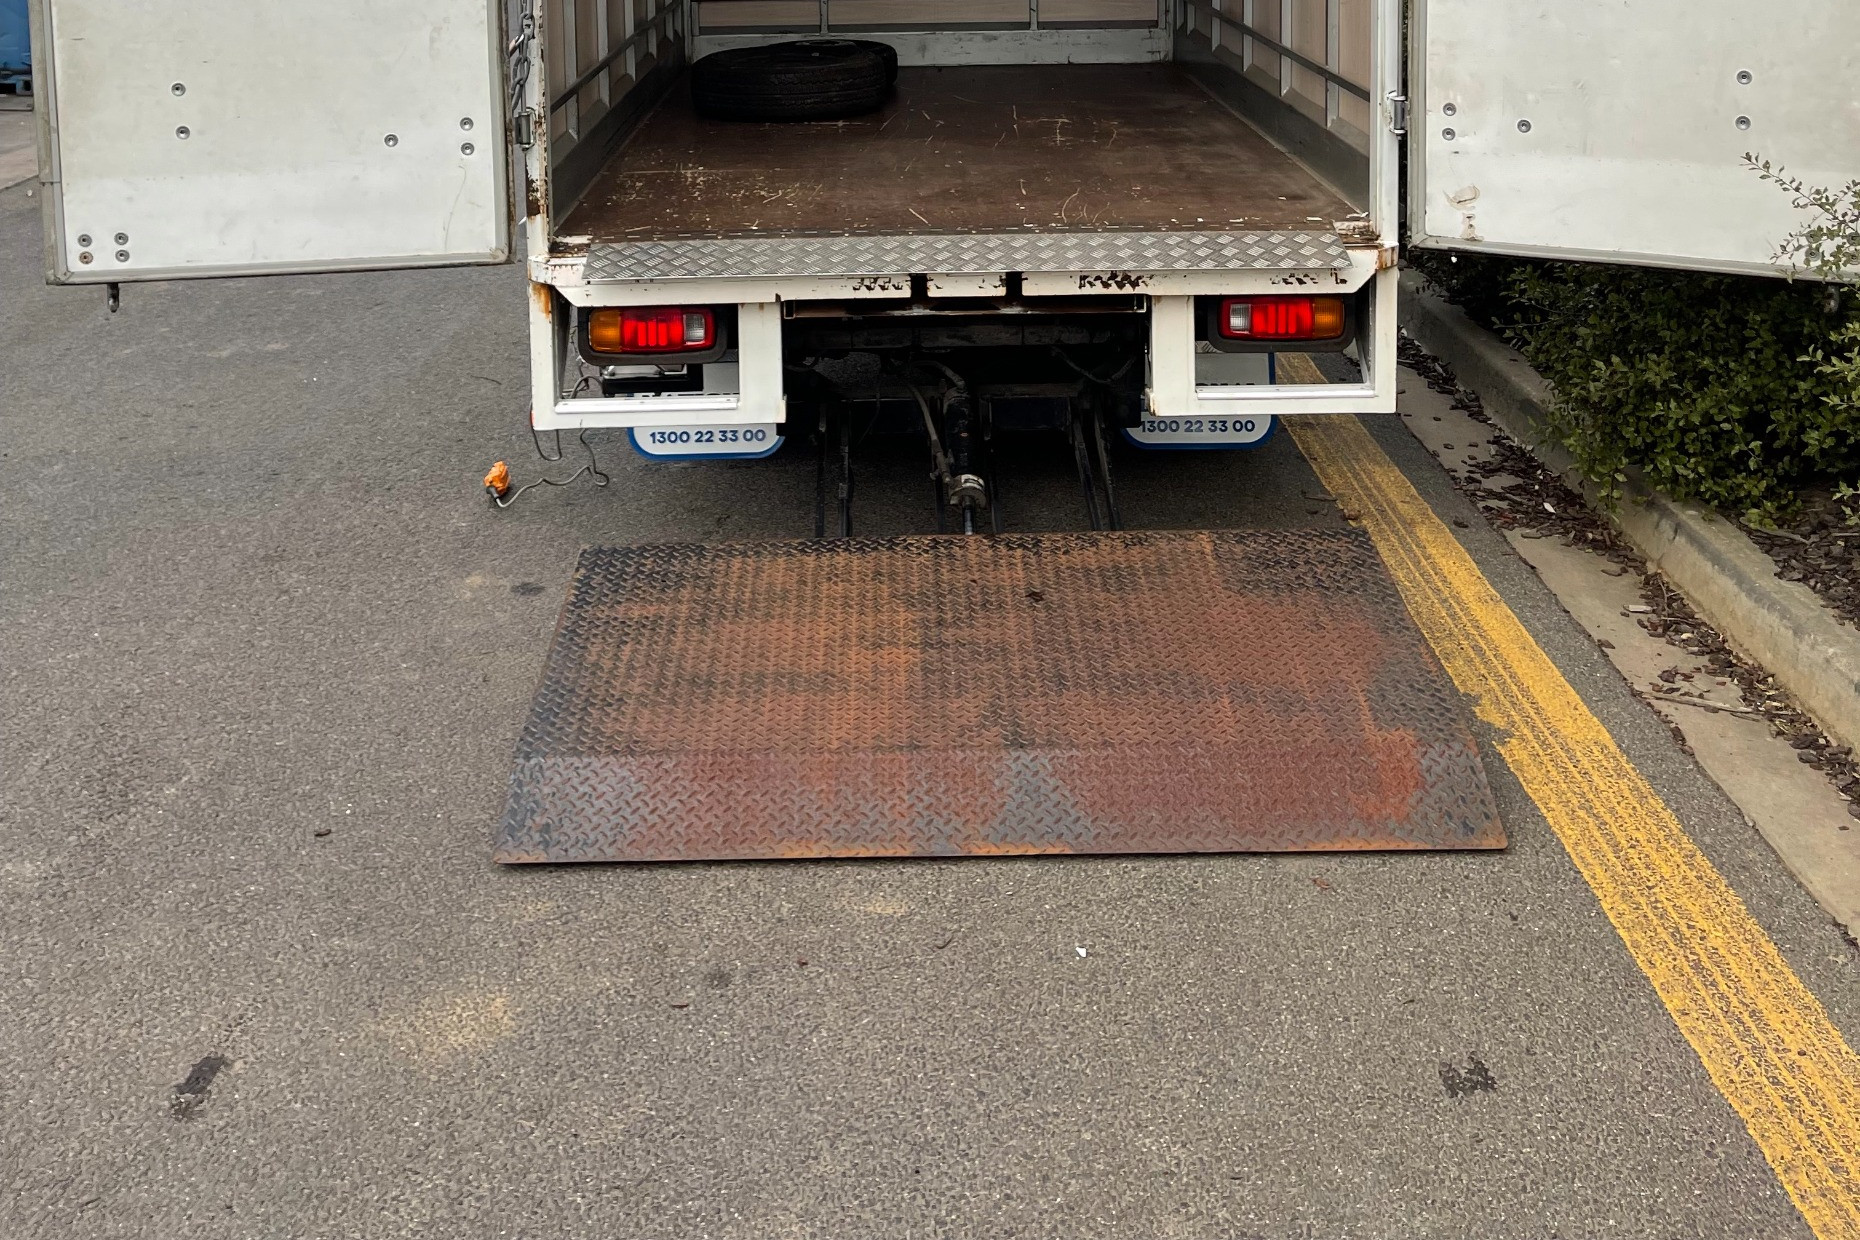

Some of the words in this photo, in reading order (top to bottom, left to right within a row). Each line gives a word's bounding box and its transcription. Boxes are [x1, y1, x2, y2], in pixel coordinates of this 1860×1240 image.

[1141, 420, 1180, 433] 1300
[1184, 420, 1204, 433] 22
[1208, 420, 1229, 433] 33
[1232, 420, 1256, 433] 00
[650, 431, 690, 444] 1300
[694, 430, 714, 443] 22
[718, 430, 739, 443] 33
[743, 429, 766, 442] 00
